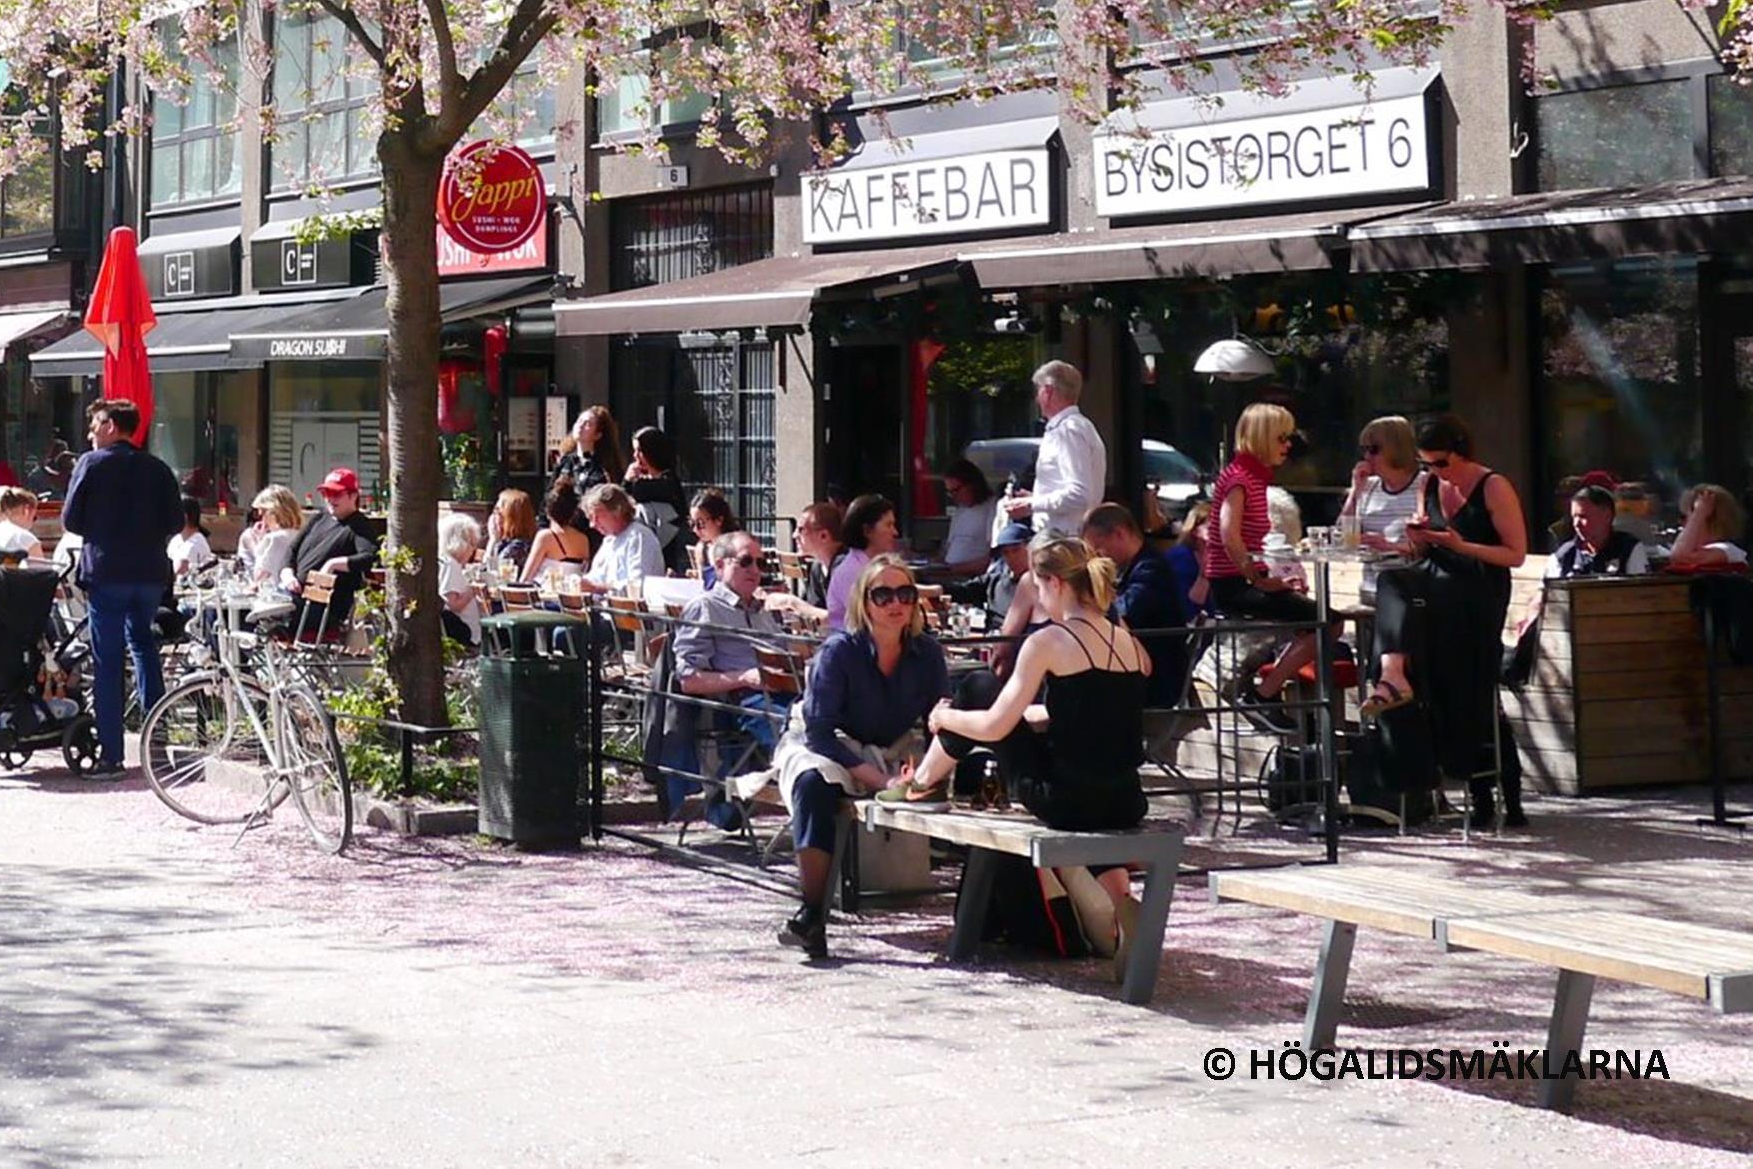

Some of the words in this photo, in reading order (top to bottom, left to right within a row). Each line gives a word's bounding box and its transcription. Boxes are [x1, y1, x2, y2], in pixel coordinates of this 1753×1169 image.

[670, 168, 678, 183] 6
[1105, 119, 1375, 197] BYSISTORGET
[1388, 117, 1412, 168] 6
[810, 158, 1037, 233] KAFFEBAR
[270, 339, 314, 356] DRAGON
[314, 338, 347, 356] SUSHI
